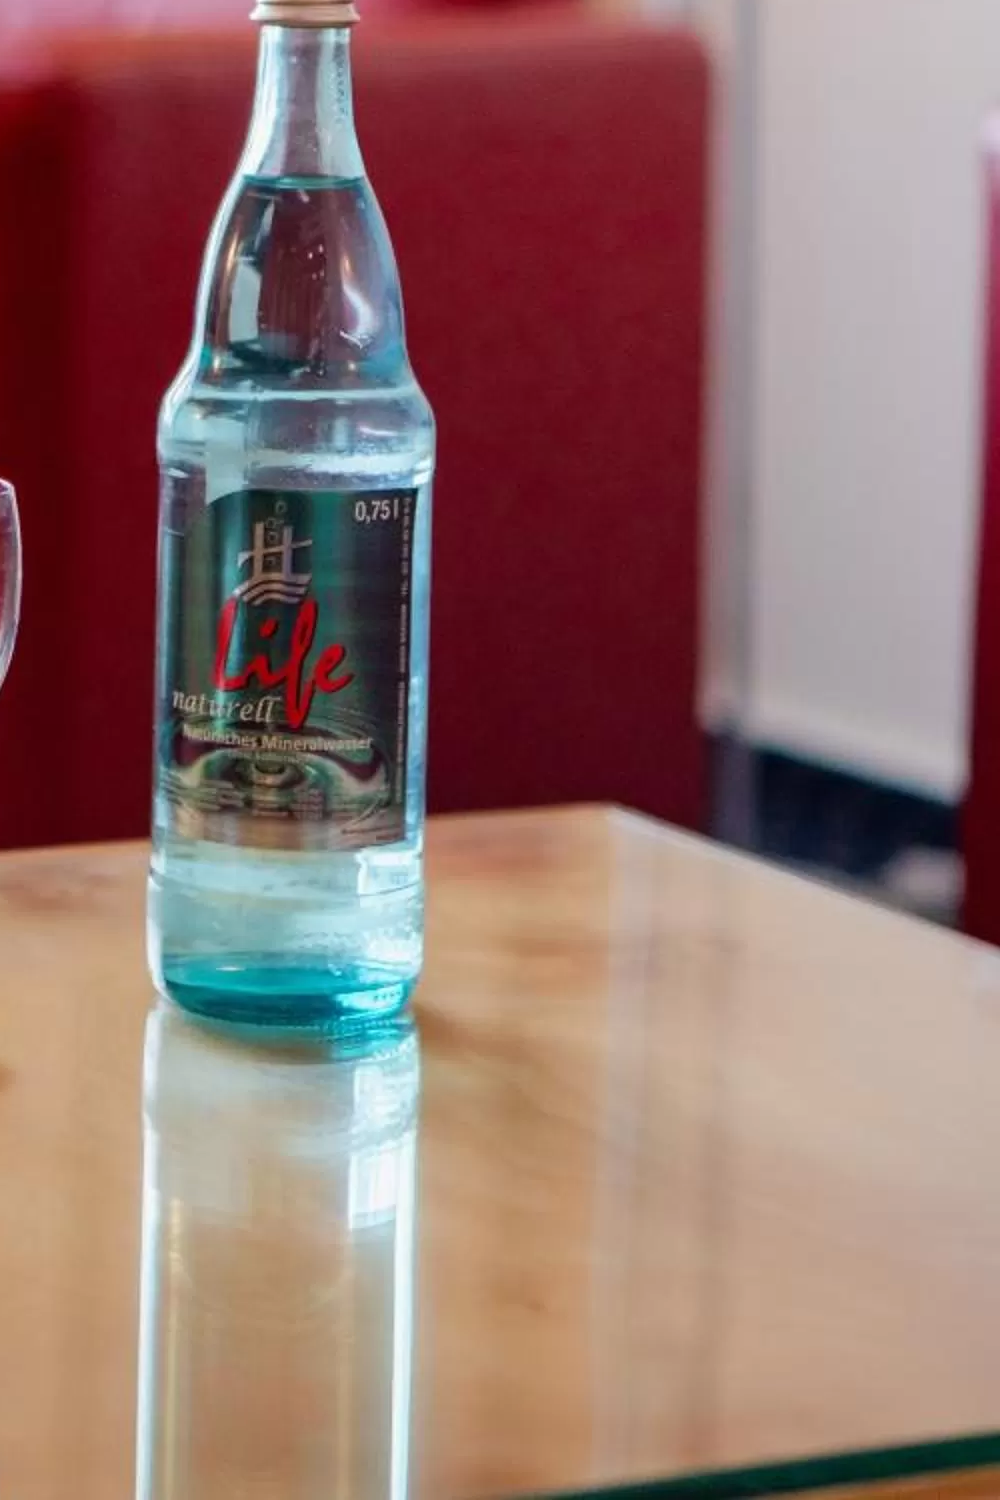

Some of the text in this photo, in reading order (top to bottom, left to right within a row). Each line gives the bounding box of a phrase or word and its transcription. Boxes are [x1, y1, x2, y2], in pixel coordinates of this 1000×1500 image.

[355, 500, 390, 523] 0,75
[211, 596, 355, 730] Life
[173, 691, 281, 723] naturell
